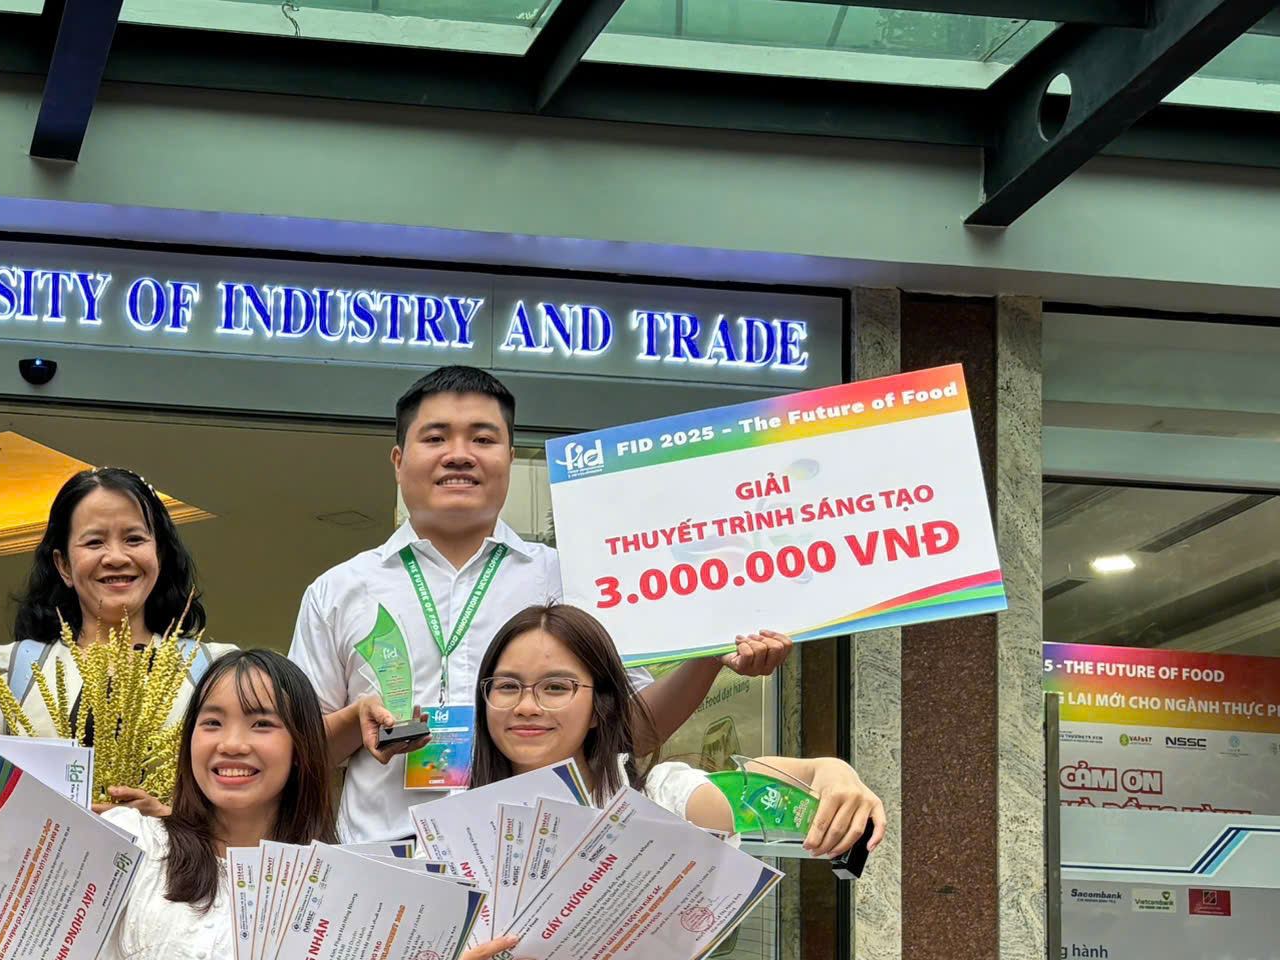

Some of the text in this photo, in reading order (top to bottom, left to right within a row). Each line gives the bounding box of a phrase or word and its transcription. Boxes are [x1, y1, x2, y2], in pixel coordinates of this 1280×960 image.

[126, 279, 199, 333] OF
[215, 282, 483, 348] INDUSTRY
[500, 300, 614, 356] AND
[631, 310, 808, 370] TRADE
[617, 438, 652, 456] FID
[660, 426, 714, 447] 2025
[738, 416, 780, 432] The
[787, 402, 864, 424] Future
[871, 392, 895, 409] of
[901, 381, 957, 404] Food
[735, 471, 790, 501] GIẢI
[606, 485, 934, 555] THUYẾT TRÌNH SÁNG TẠO
[595, 521, 960, 608] 3.000.000 VNĐ
[1064, 660, 1094, 675] THE
[1097, 662, 1156, 678] FUTURE
[1159, 668, 1178, 680] OF
[1182, 669, 1225, 683] FOOD
[1068, 693, 1092, 706] LAI
[1095, 692, 1126, 708] MỚI
[1129, 696, 1161, 711] CHO
[1165, 697, 1220, 714] NGÀNH
[1223, 701, 1265, 719] THỰC
[1165, 736, 1207, 748] NSSC
[1059, 760, 1163, 795] CẢM ƠN
[81, 883, 97, 908] GIẤY
[541, 852, 618, 938] GIẤY CHỨNG NHẬN
[1071, 888, 1122, 900] Sacombank
[64, 907, 86, 945] CHỨNG
[307, 917, 329, 956] NHẬN
[1072, 944, 1108, 959] hành
